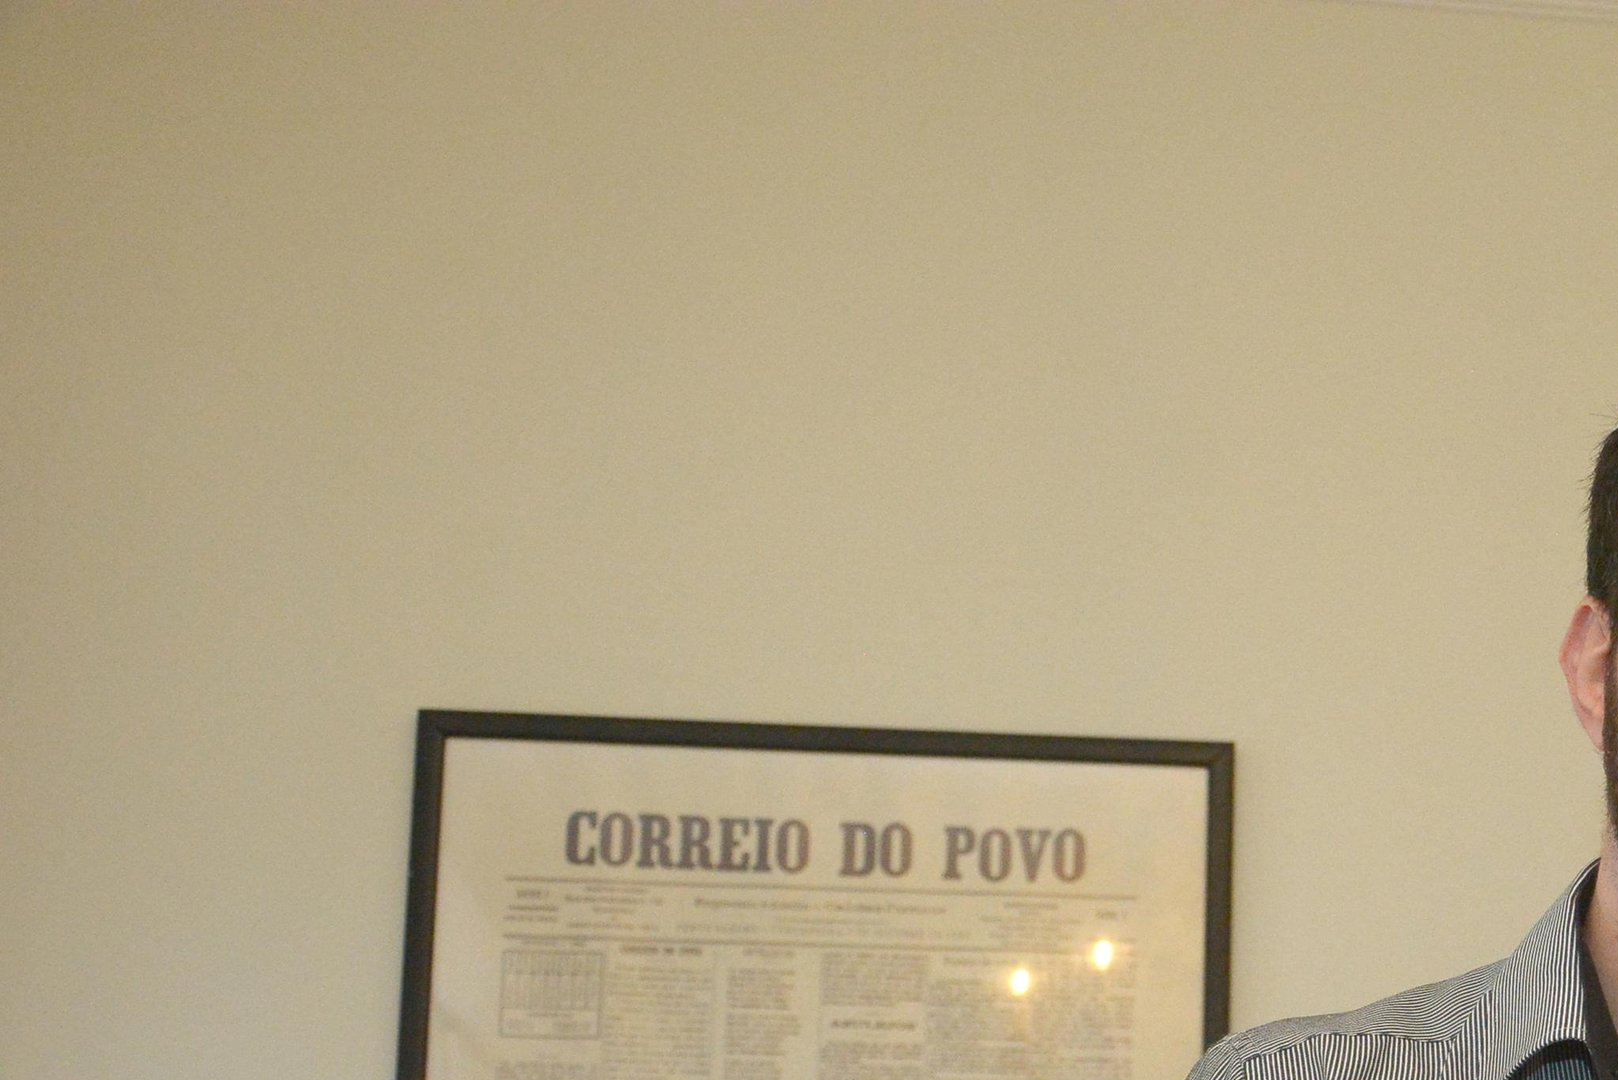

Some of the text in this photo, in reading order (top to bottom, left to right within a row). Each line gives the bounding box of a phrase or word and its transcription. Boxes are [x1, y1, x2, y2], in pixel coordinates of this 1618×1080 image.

[565, 810, 1087, 884] CORREIO DO POVO
